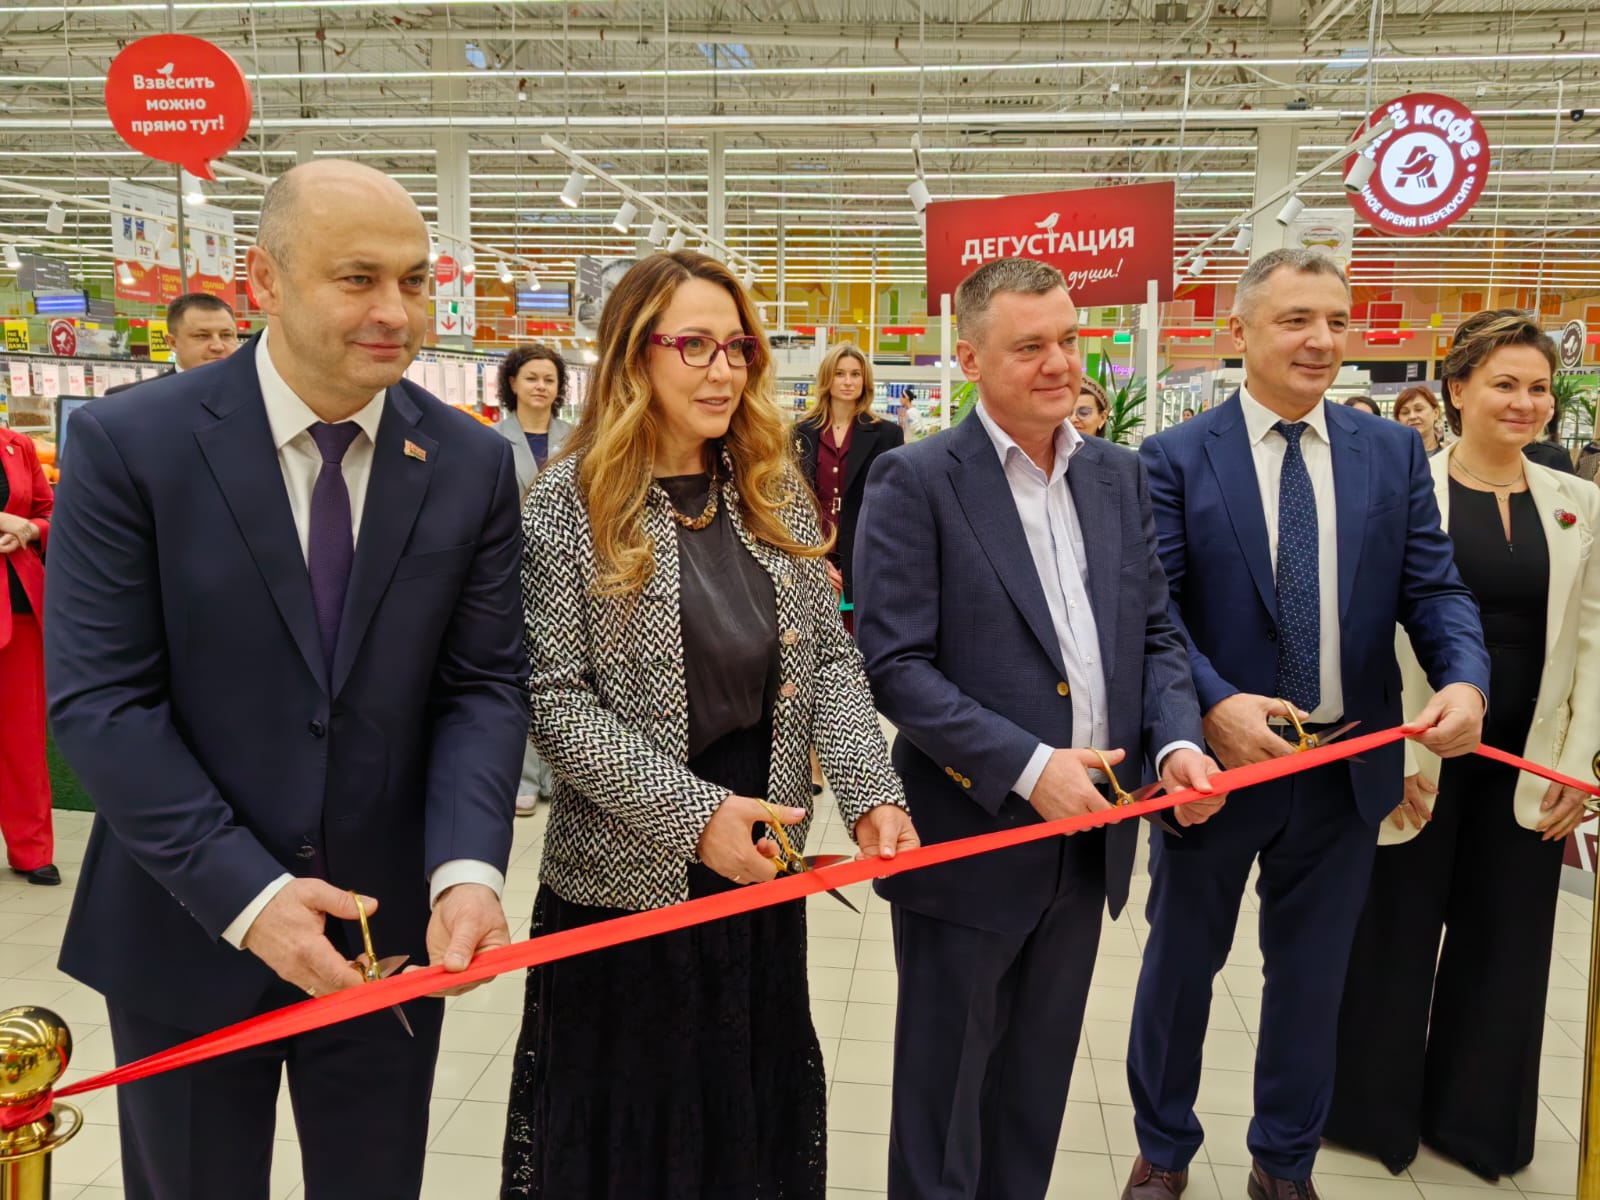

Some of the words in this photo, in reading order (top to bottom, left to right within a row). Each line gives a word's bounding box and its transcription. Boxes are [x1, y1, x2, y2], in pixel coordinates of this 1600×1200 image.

[132, 74, 216, 90] Взвесить
[145, 98, 207, 111] можно
[131, 119, 187, 136] прямо
[189, 114, 225, 135] тут!
[1380, 208, 1417, 228] ВРЕМЯ
[1418, 175, 1475, 227] ПЕРЕКУСИТЬ
[961, 226, 1135, 266] ДЕГУСТАЦИЯ
[1067, 258, 1124, 291] души!
